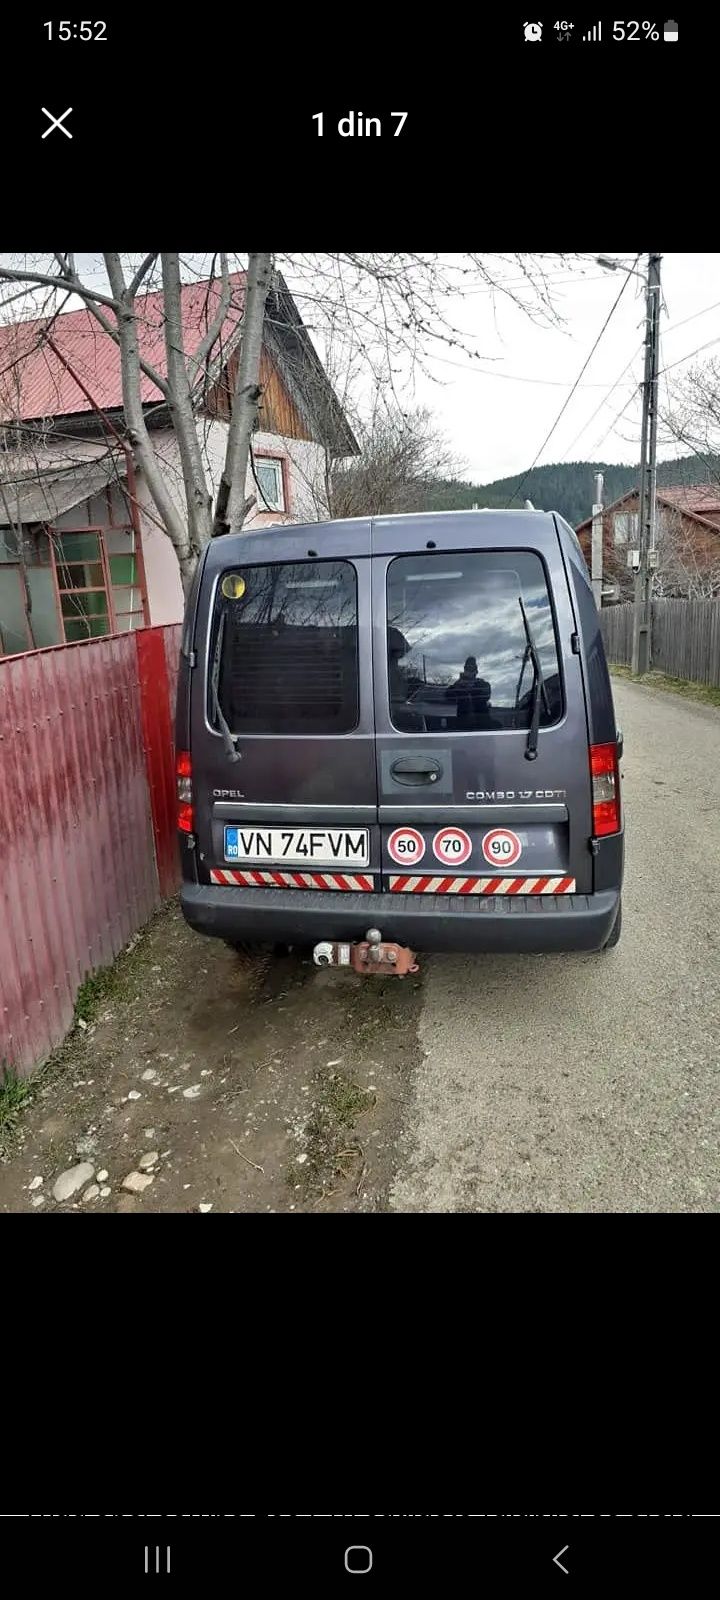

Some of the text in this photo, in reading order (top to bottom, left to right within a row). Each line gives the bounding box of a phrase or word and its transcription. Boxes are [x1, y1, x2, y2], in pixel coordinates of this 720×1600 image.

[212, 788, 245, 798] OPEL
[466, 790, 515, 800] COMBO
[228, 845, 238, 855] RO
[240, 832, 365, 858] VN 74FVM
[397, 840, 416, 854] 50
[442, 839, 461, 853] 70
[491, 841, 511, 855] 90
